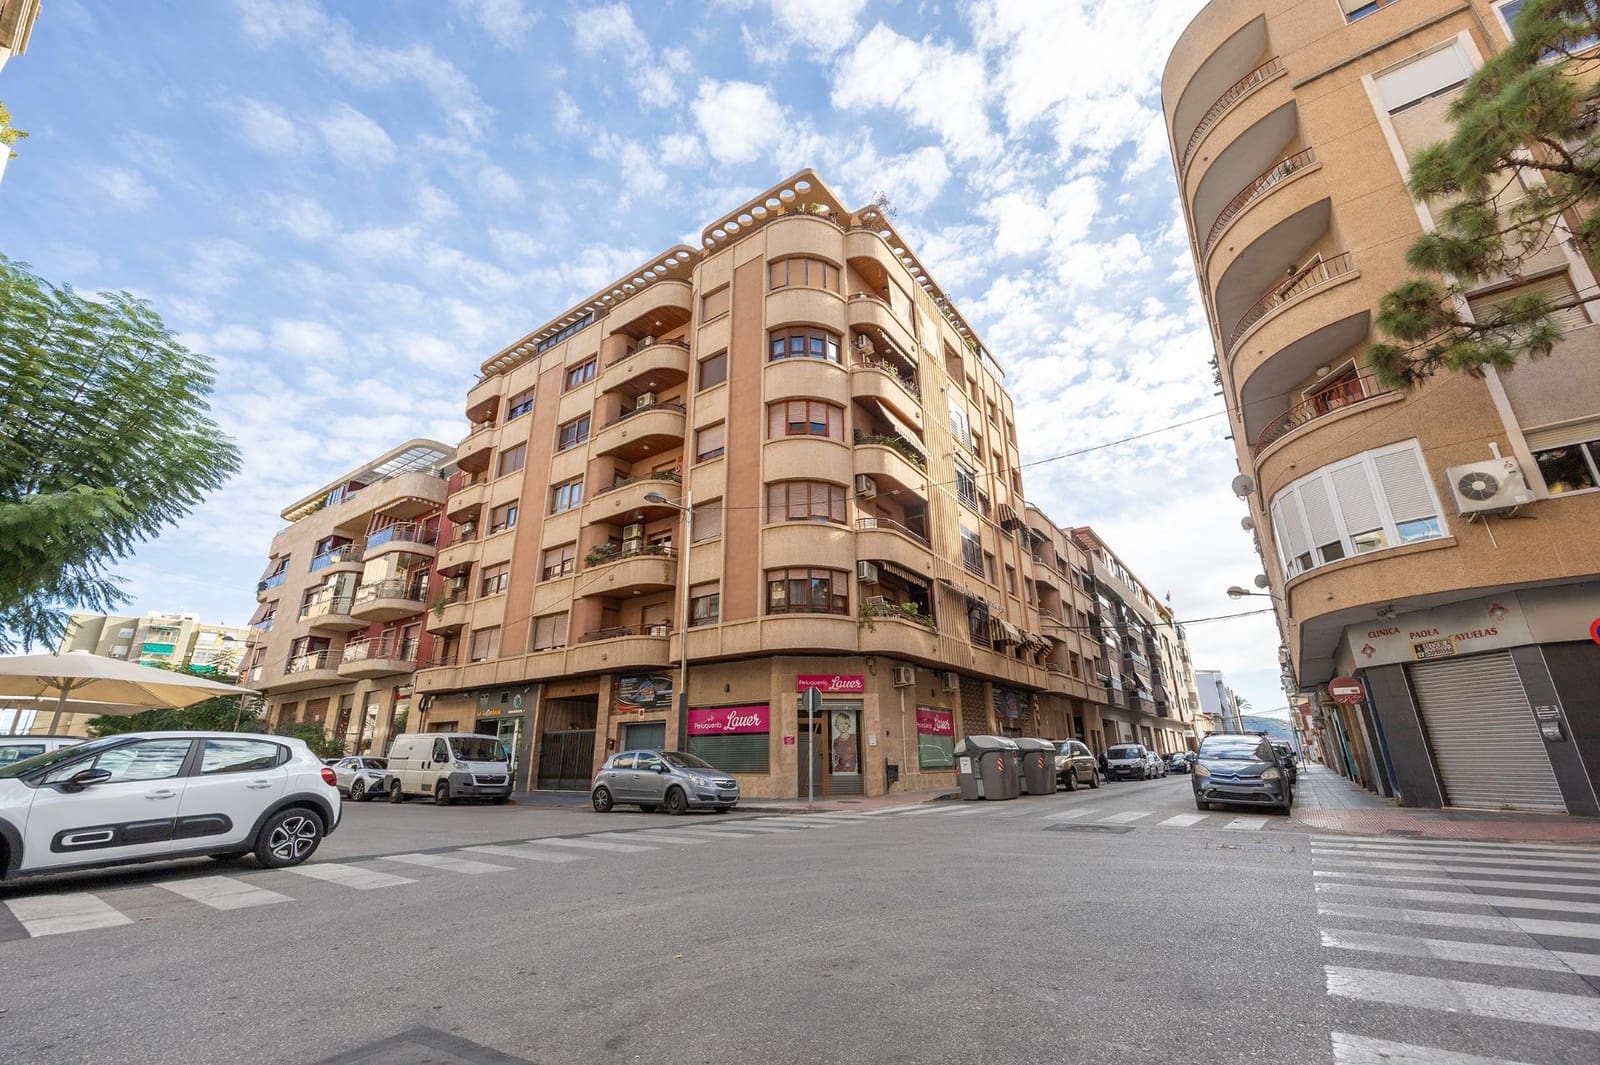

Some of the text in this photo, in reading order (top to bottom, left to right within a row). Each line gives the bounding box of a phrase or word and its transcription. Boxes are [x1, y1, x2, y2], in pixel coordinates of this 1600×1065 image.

[1409, 628, 1440, 639] PAOLA
[828, 676, 863, 690] Lauer
[724, 711, 762, 731] Lauer
